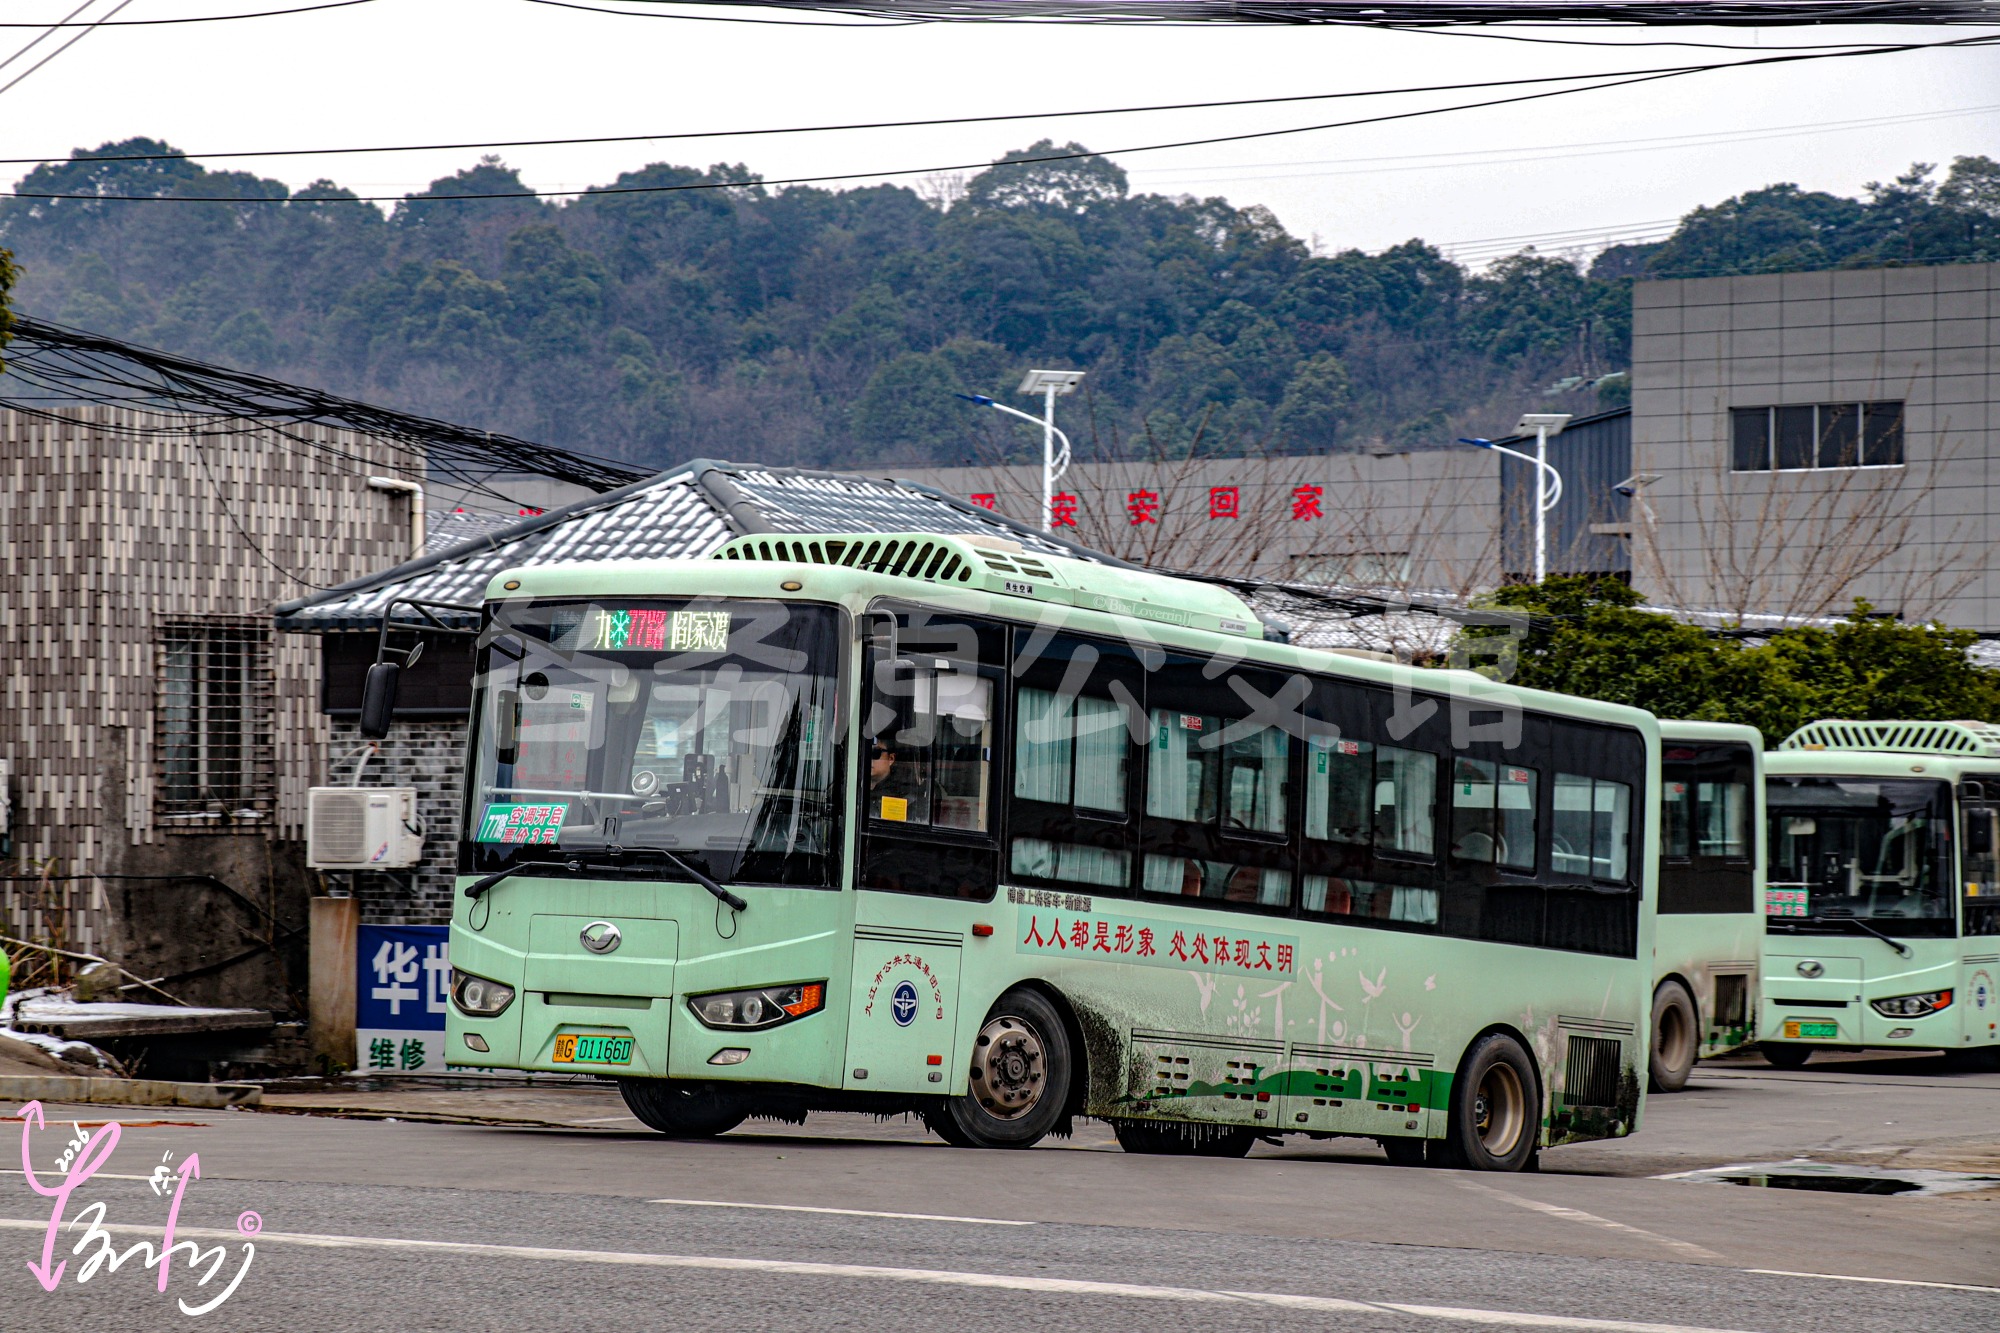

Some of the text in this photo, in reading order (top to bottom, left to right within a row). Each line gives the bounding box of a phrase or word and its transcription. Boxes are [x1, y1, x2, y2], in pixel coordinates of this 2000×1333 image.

[628, 609, 667, 650] 77路
[508, 806, 563, 826] 空调开启
[501, 827, 556, 844] 票价3元
[1023, 914, 1294, 974] 人人都是形象 处处体现文明
[865, 953, 943, 1020] 九江市公共交通集团公司
[369, 1037, 426, 1071] 维修
